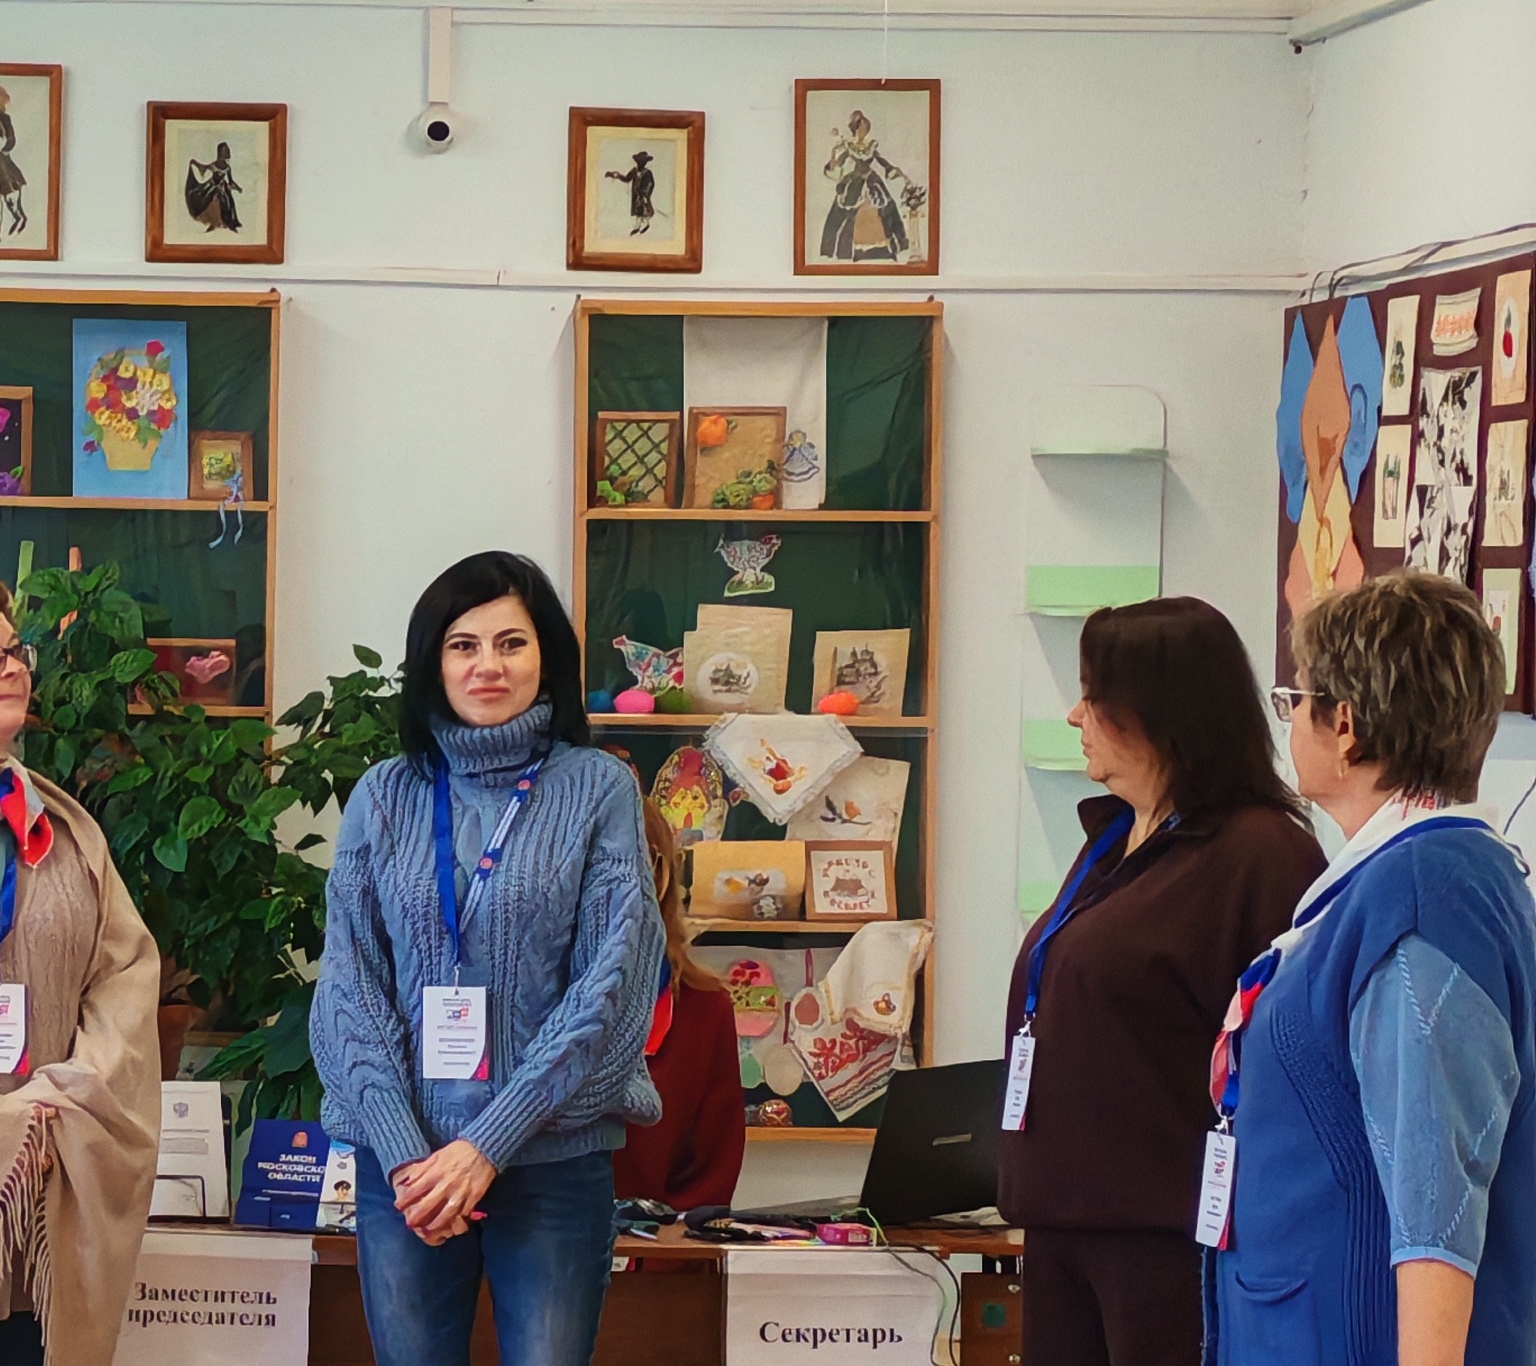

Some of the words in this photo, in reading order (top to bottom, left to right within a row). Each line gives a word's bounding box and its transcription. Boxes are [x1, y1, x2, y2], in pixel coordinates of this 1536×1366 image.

[279, 1153, 317, 1164] ЗАКОН
[257, 1162, 327, 1174] МОСКОВСКО
[267, 1171, 322, 1183] ОБЛАСТИ
[134, 1282, 278, 1305] Заместитель
[127, 1308, 277, 1328] председателя
[758, 1321, 904, 1350] Секретарь
